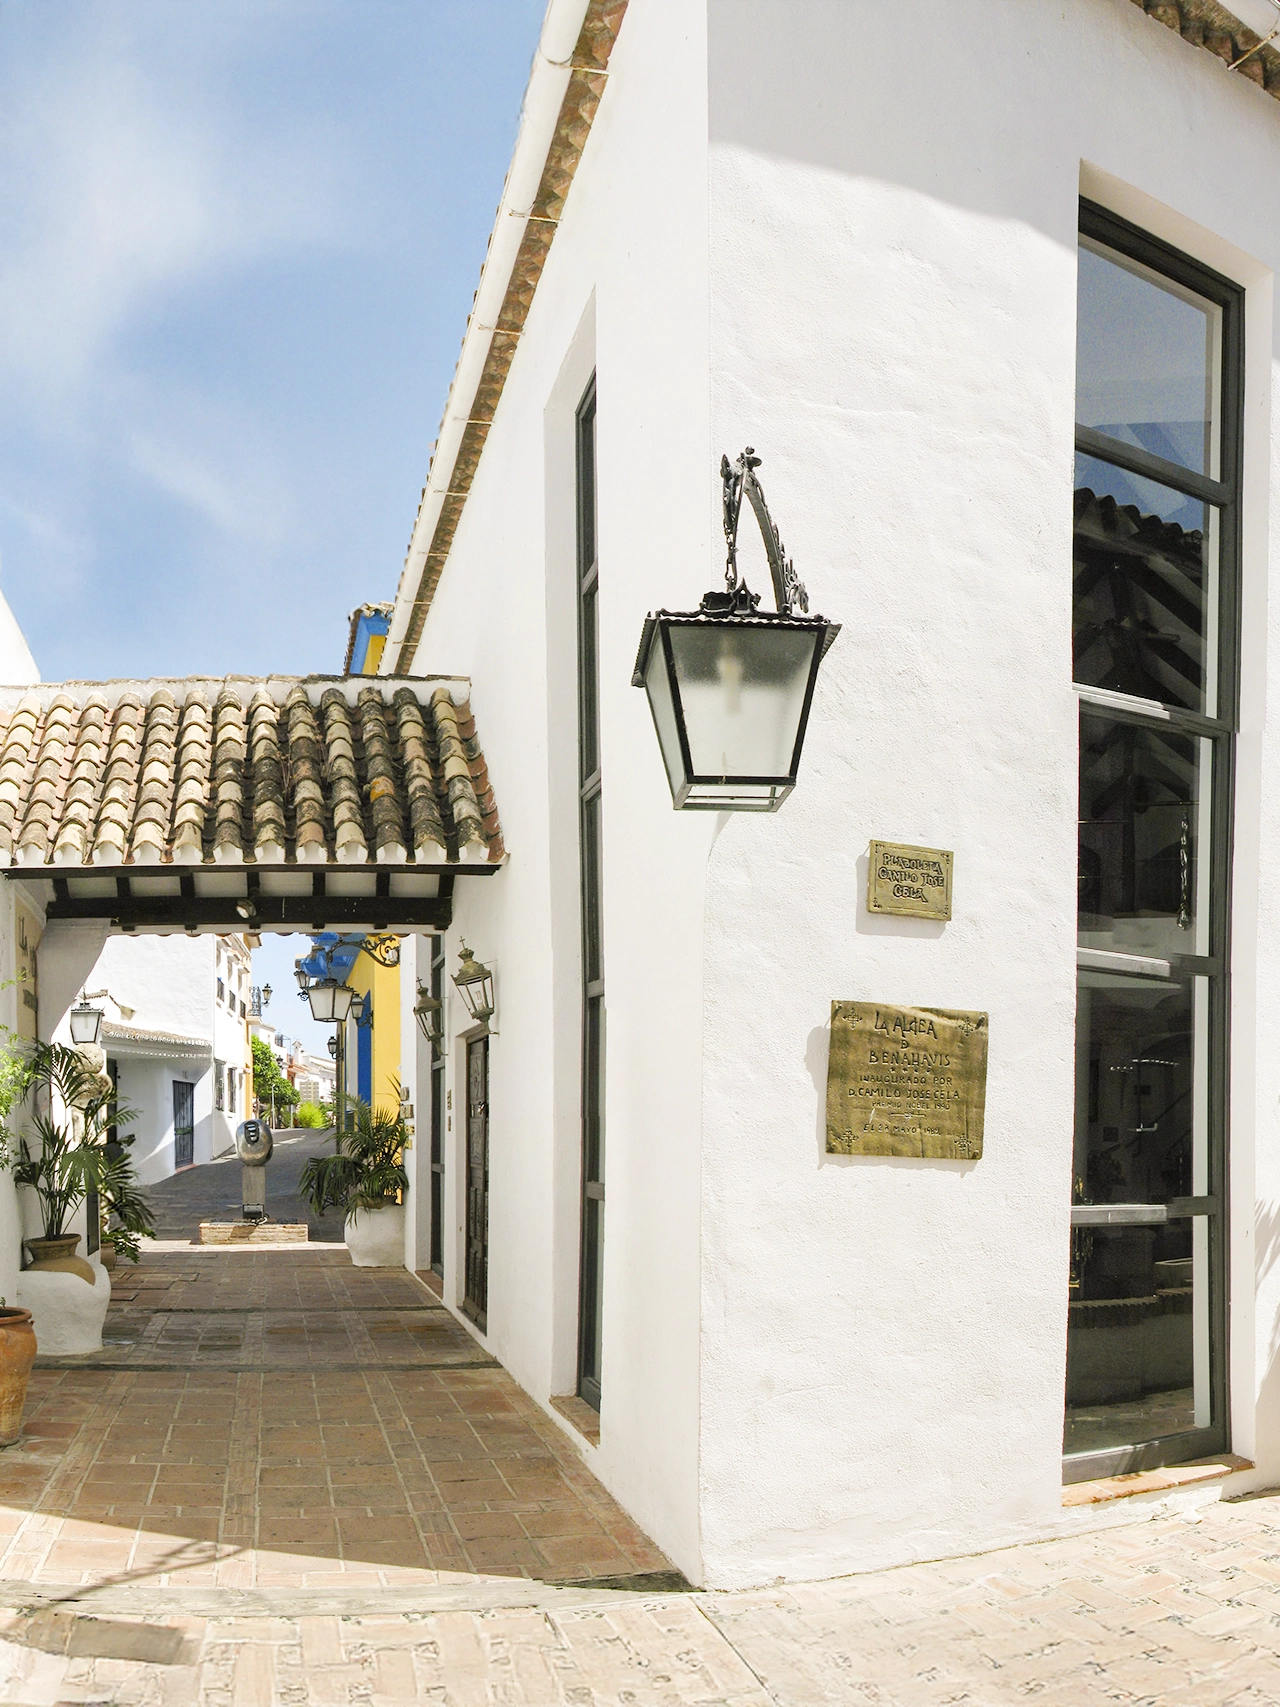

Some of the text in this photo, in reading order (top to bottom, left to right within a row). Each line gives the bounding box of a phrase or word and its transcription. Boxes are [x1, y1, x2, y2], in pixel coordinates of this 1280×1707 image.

[878, 866, 944, 887] CAMILO JOSE
[893, 884, 928, 902] CELA
[875, 1010, 938, 1040] LA ALDEA
[869, 1050, 951, 1067] BENAHAVIS
[860, 1075, 953, 1086] INAUGURADO POR
[907, 1089, 930, 1099] JOSE
[933, 1089, 960, 1100] CELA
[906, 1103, 930, 1111] NOBEL
[893, 1126, 916, 1134] MAYO
